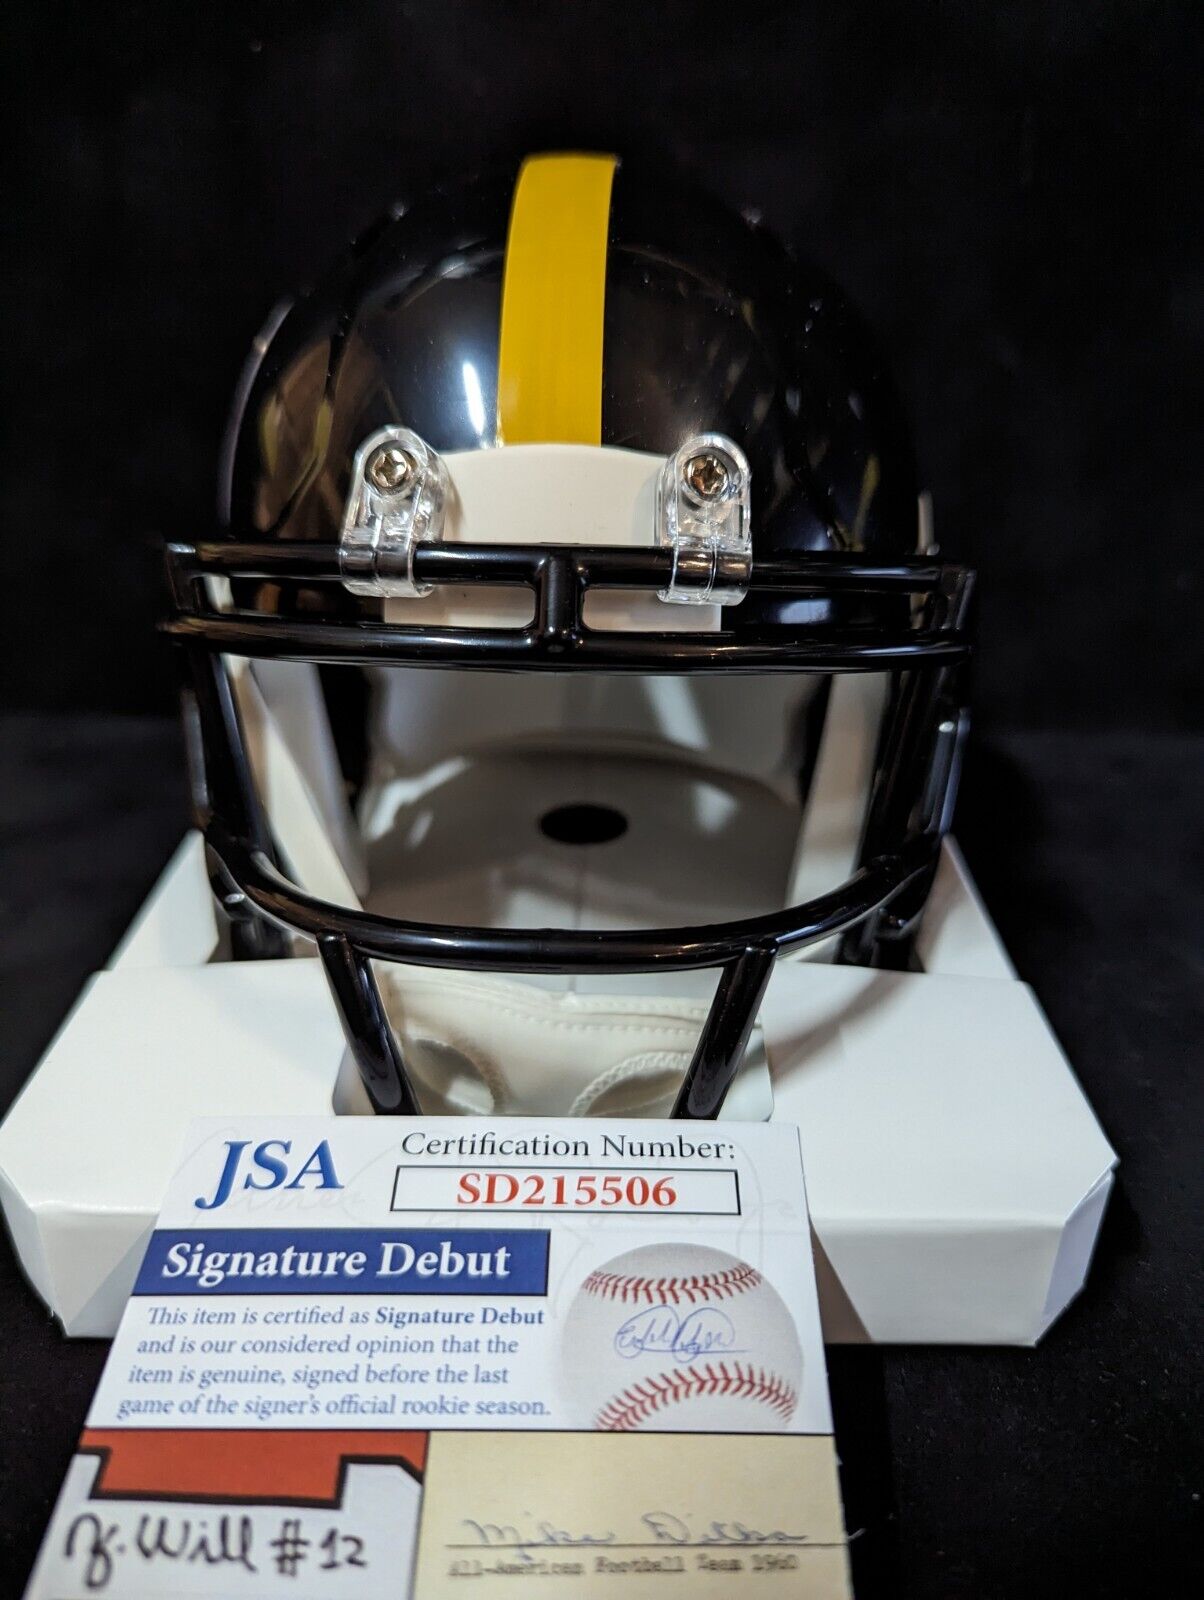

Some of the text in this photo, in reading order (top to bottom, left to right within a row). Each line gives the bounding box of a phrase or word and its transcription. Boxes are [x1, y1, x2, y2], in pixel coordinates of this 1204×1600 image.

[401, 1132, 736, 1160] Certification Number:
[194, 1139, 344, 1210] JSA
[456, 1172, 677, 1207] SD215506
[161, 1241, 511, 1288] Signature Debut
[149, 1306, 544, 1329] This item is certified as Signature Debut
[137, 1335, 519, 1359] and is our considered opinion that the
[128, 1364, 509, 1389] item is genuine, signed before the last
[116, 1402, 174, 1421] game
[179, 1394, 206, 1415] of
[206, 1396, 240, 1415] the
[325, 1393, 396, 1416] official
[401, 1395, 471, 1416] rookie
[475, 1400, 552, 1416] season.
[135, 1514, 257, 1573] Will
